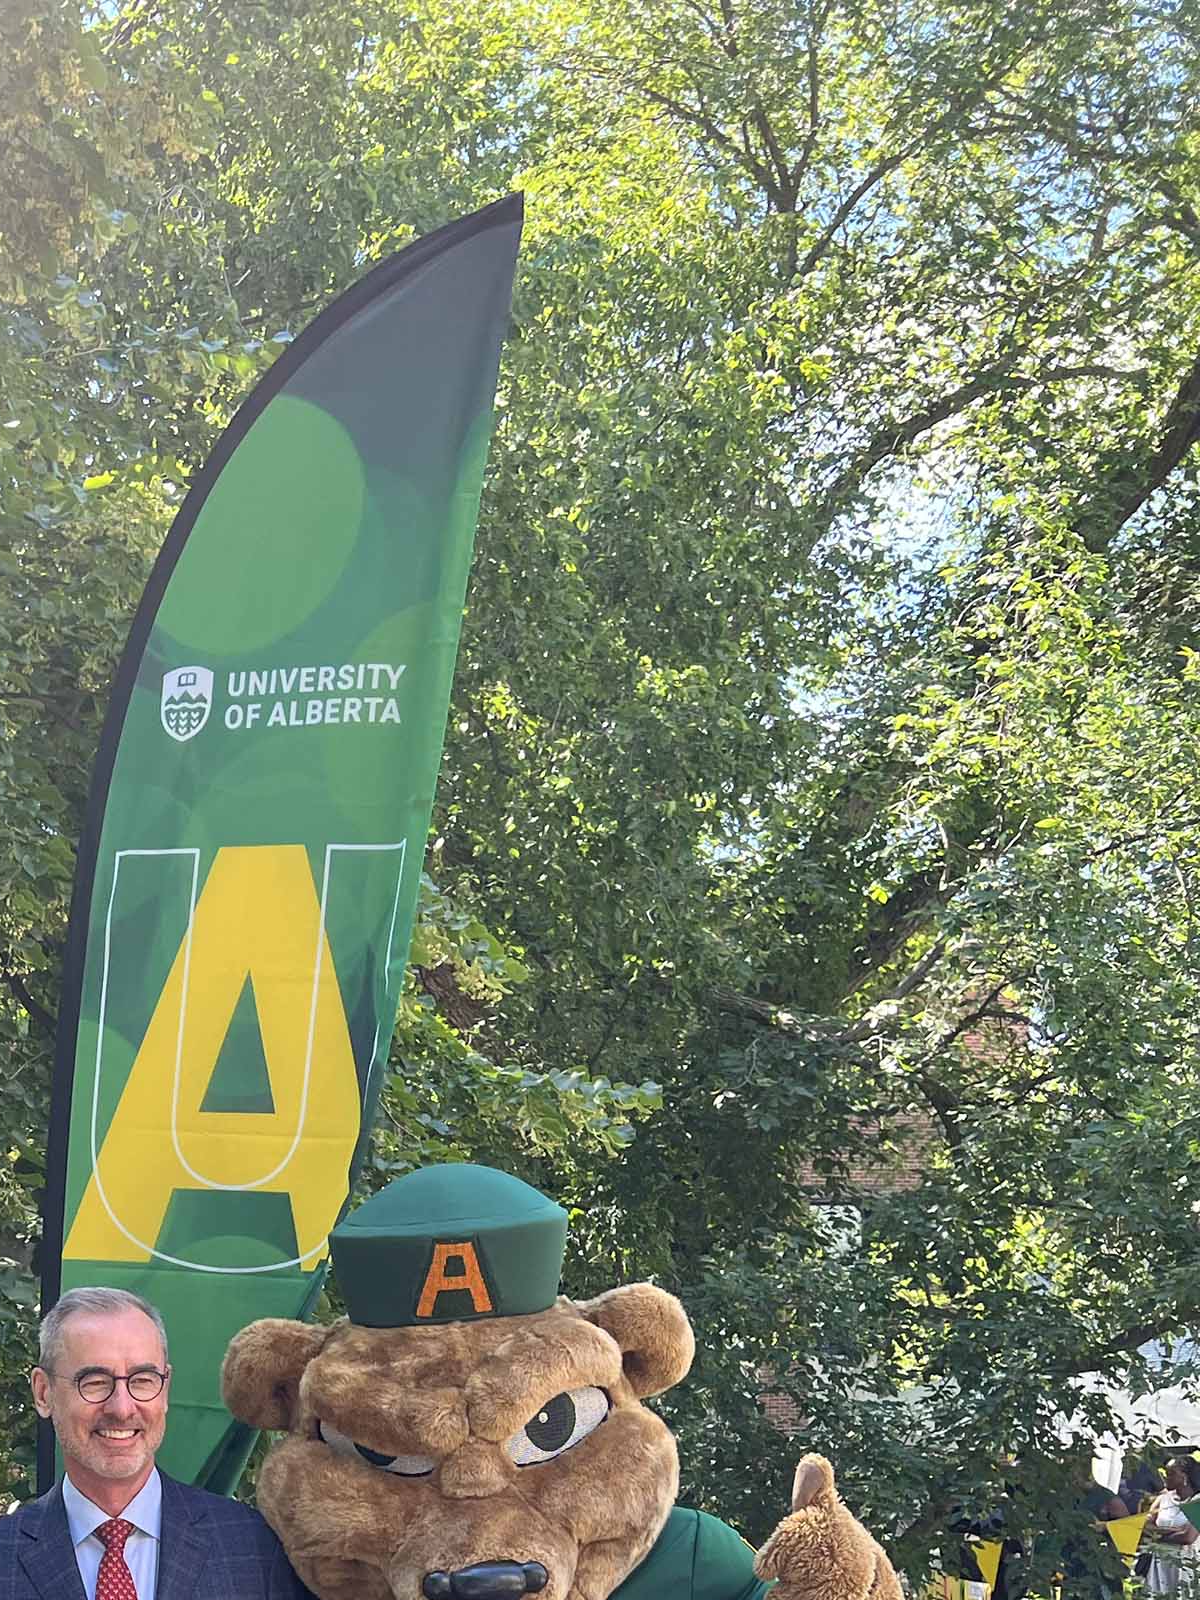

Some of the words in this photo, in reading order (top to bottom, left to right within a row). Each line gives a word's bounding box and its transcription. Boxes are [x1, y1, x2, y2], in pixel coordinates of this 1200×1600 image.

[228, 664, 407, 697] UNIVERSITY
[224, 703, 261, 729] OF
[266, 697, 402, 727] ALBERTA
[61, 843, 362, 1272] A
[416, 1240, 493, 1318] A
